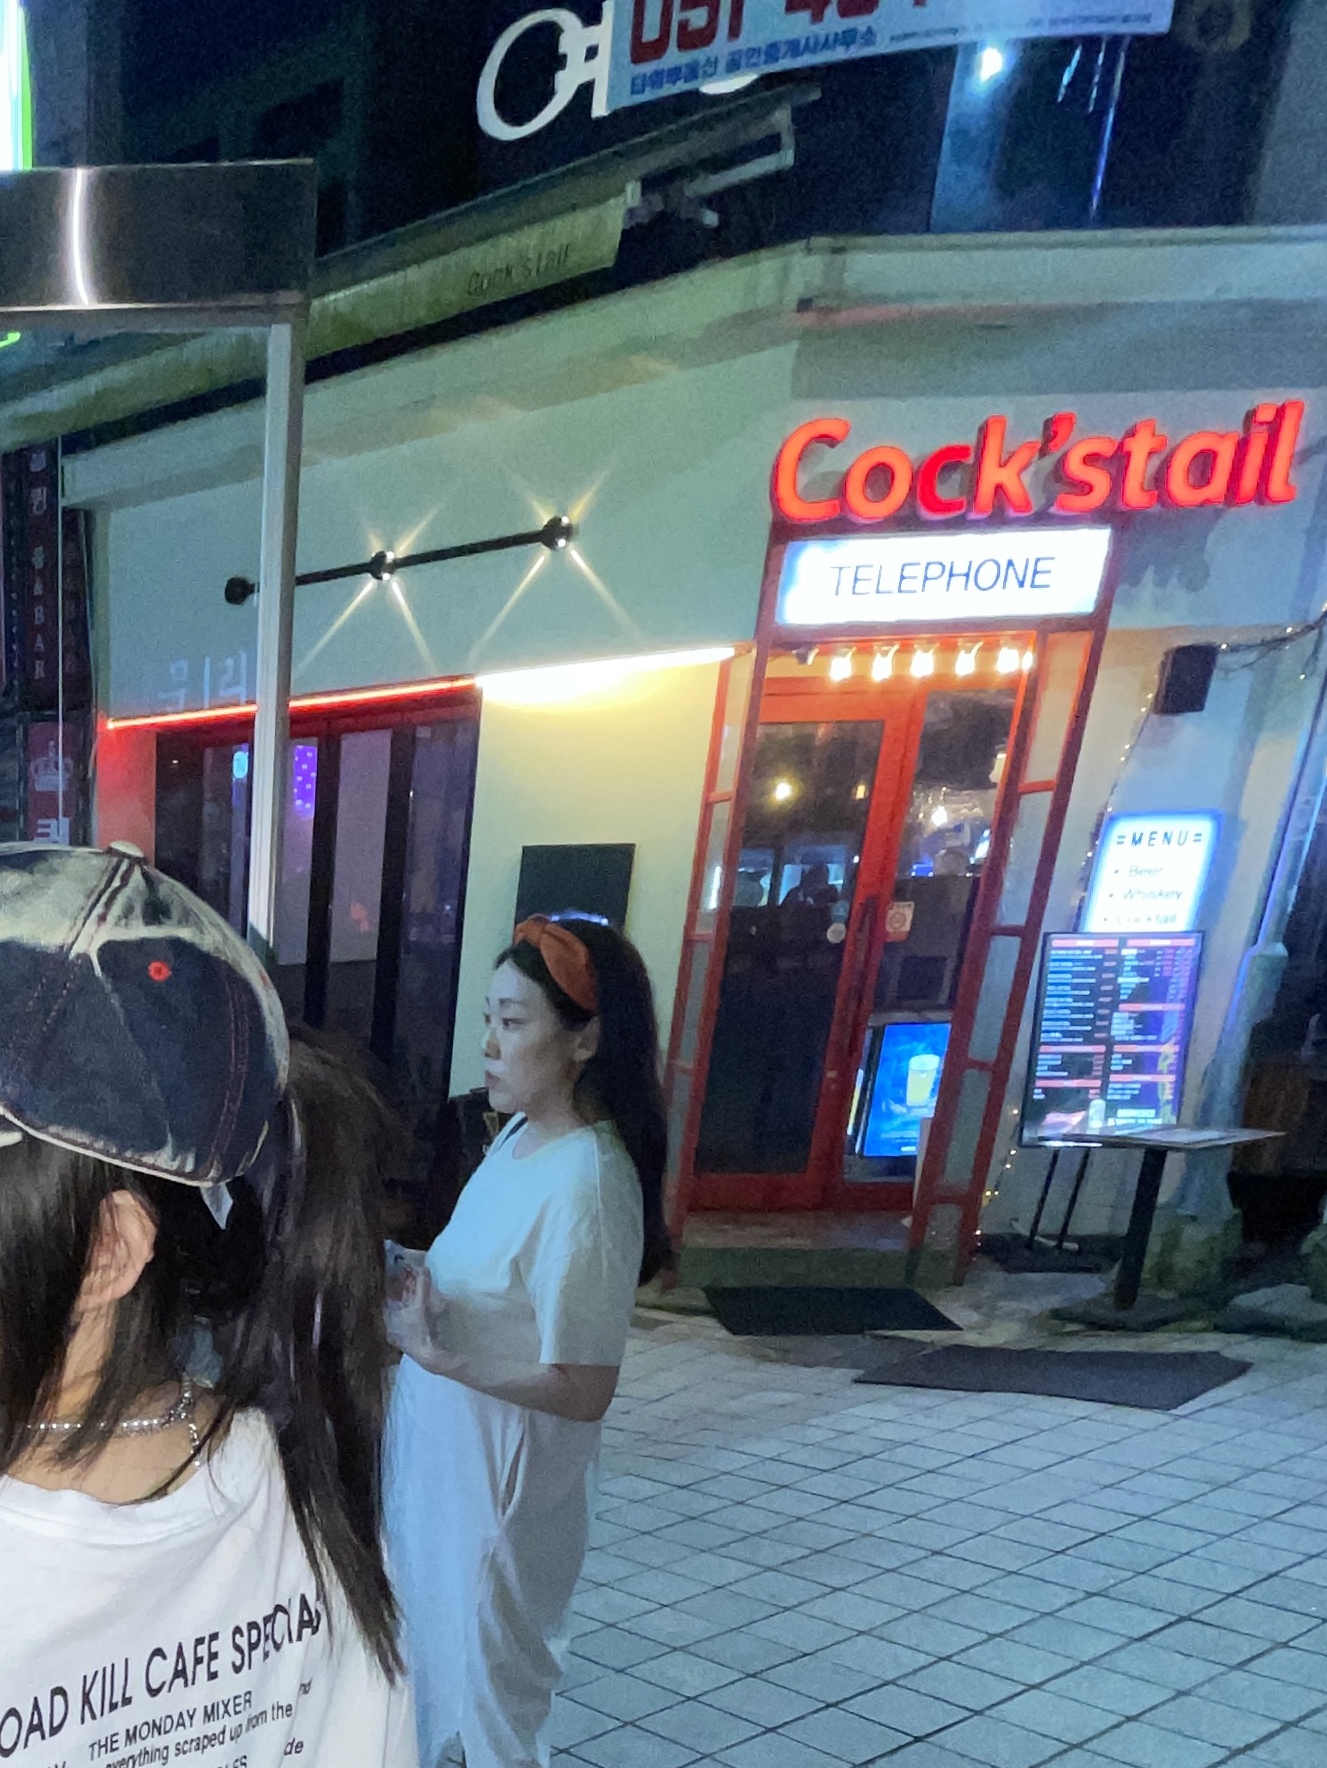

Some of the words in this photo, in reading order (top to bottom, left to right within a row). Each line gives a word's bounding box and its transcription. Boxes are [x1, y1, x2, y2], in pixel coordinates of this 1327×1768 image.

[771, 400, 1305, 521] Cock'stail
[830, 556, 1056, 597] TELEPHONE
[80, 1657, 133, 1725] KILL
[145, 1631, 220, 1698] CAFE
[88, 1732, 120, 1762] THE
[124, 1707, 197, 1747] MONDAY
[202, 1690, 252, 1725] MIXER
[174, 1725, 226, 1757] scraped
[271, 1701, 293, 1722] the
